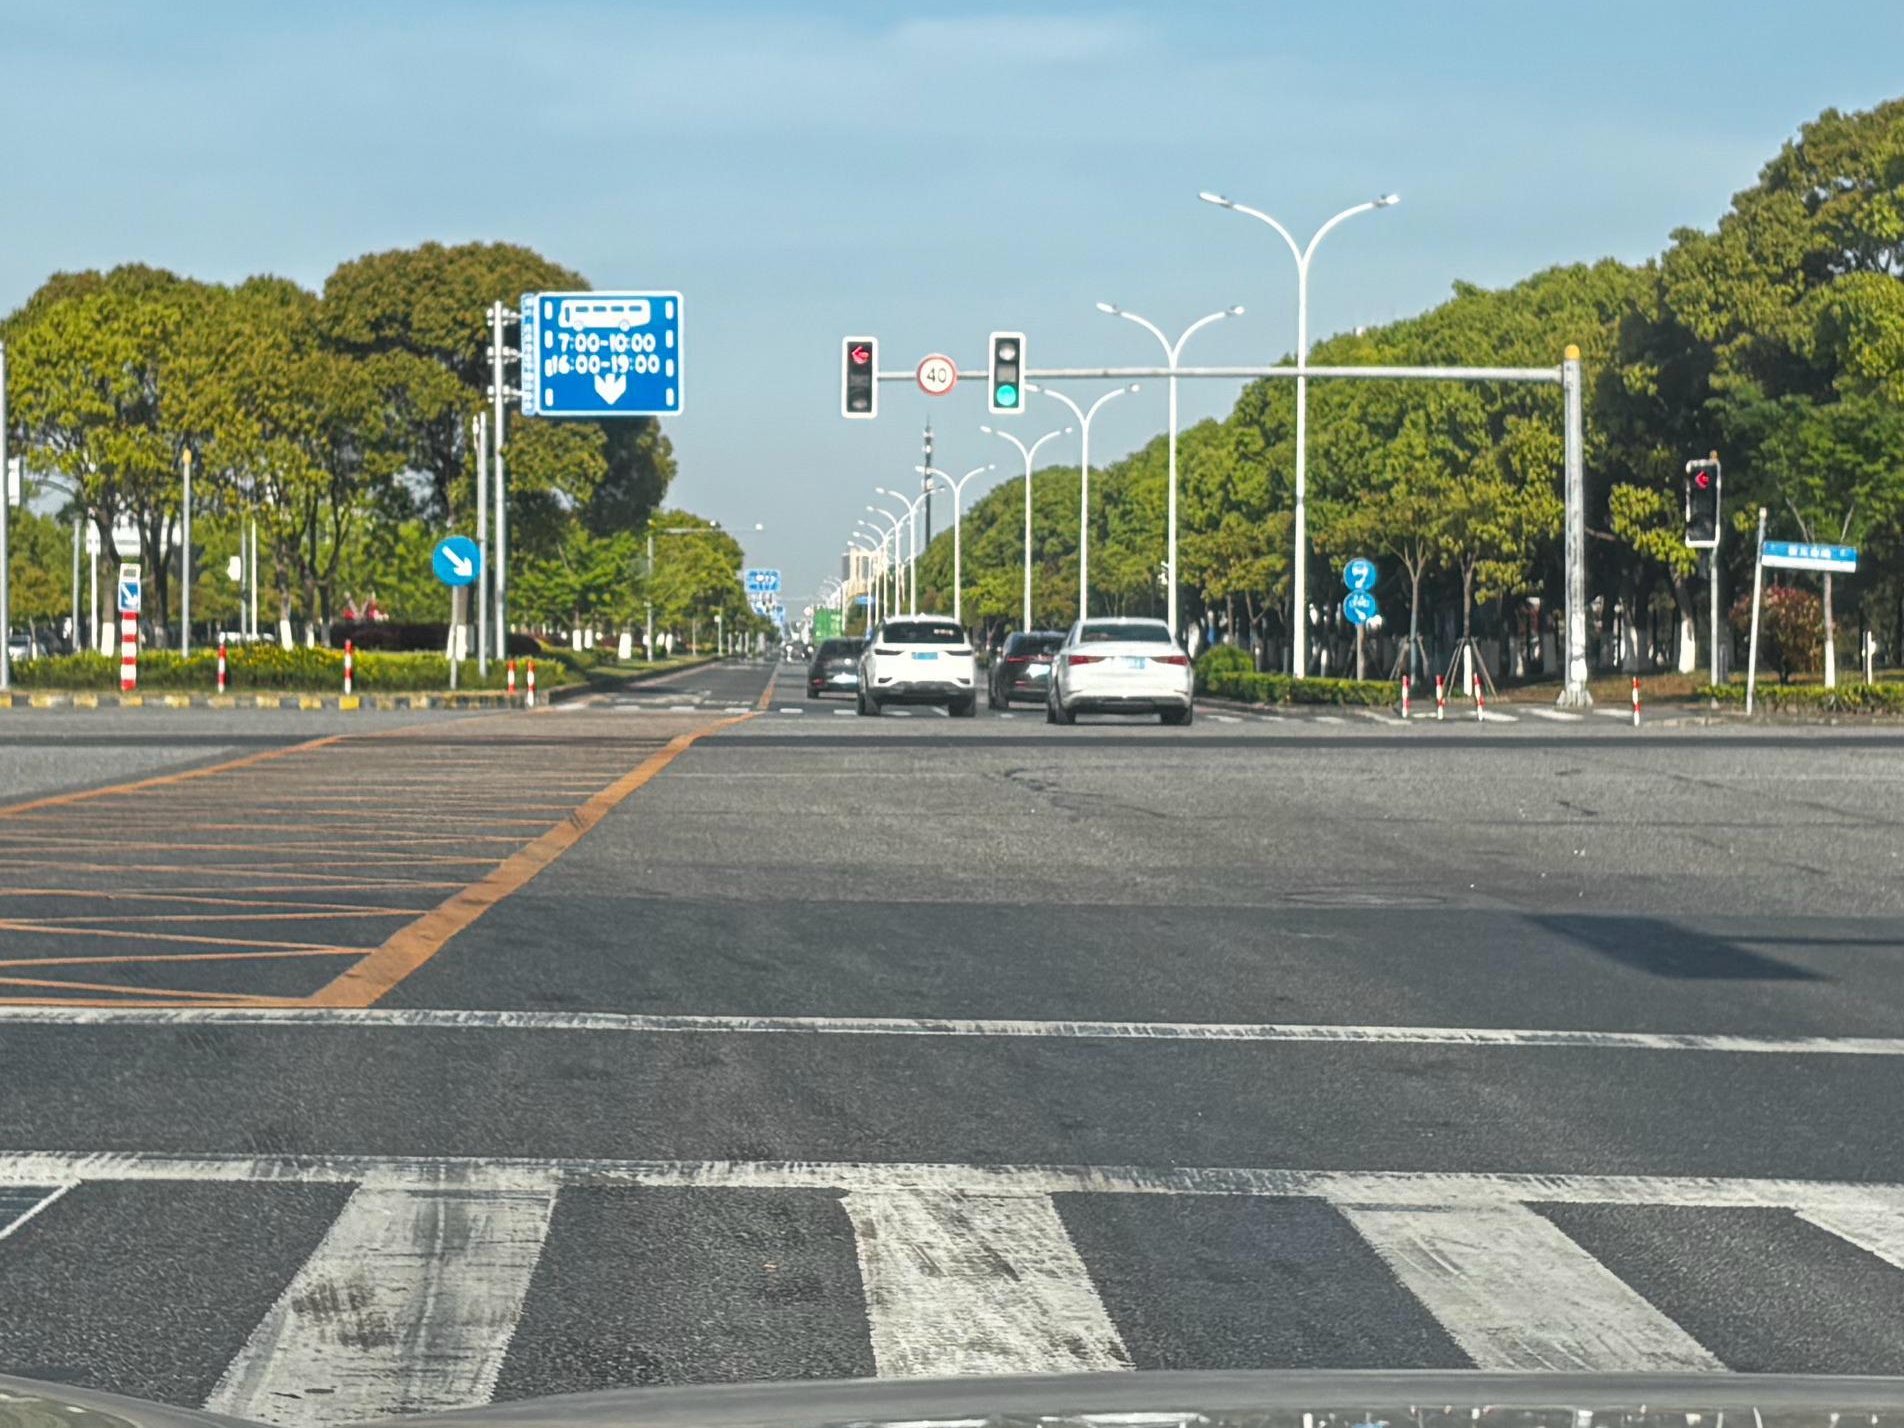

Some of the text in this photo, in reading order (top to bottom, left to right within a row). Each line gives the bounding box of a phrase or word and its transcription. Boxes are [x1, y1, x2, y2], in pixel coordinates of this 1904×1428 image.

[557, 332, 656, 353] 7:00-10:00
[551, 354, 660, 374] 16:00-19:00
[926, 367, 947, 383] 40
